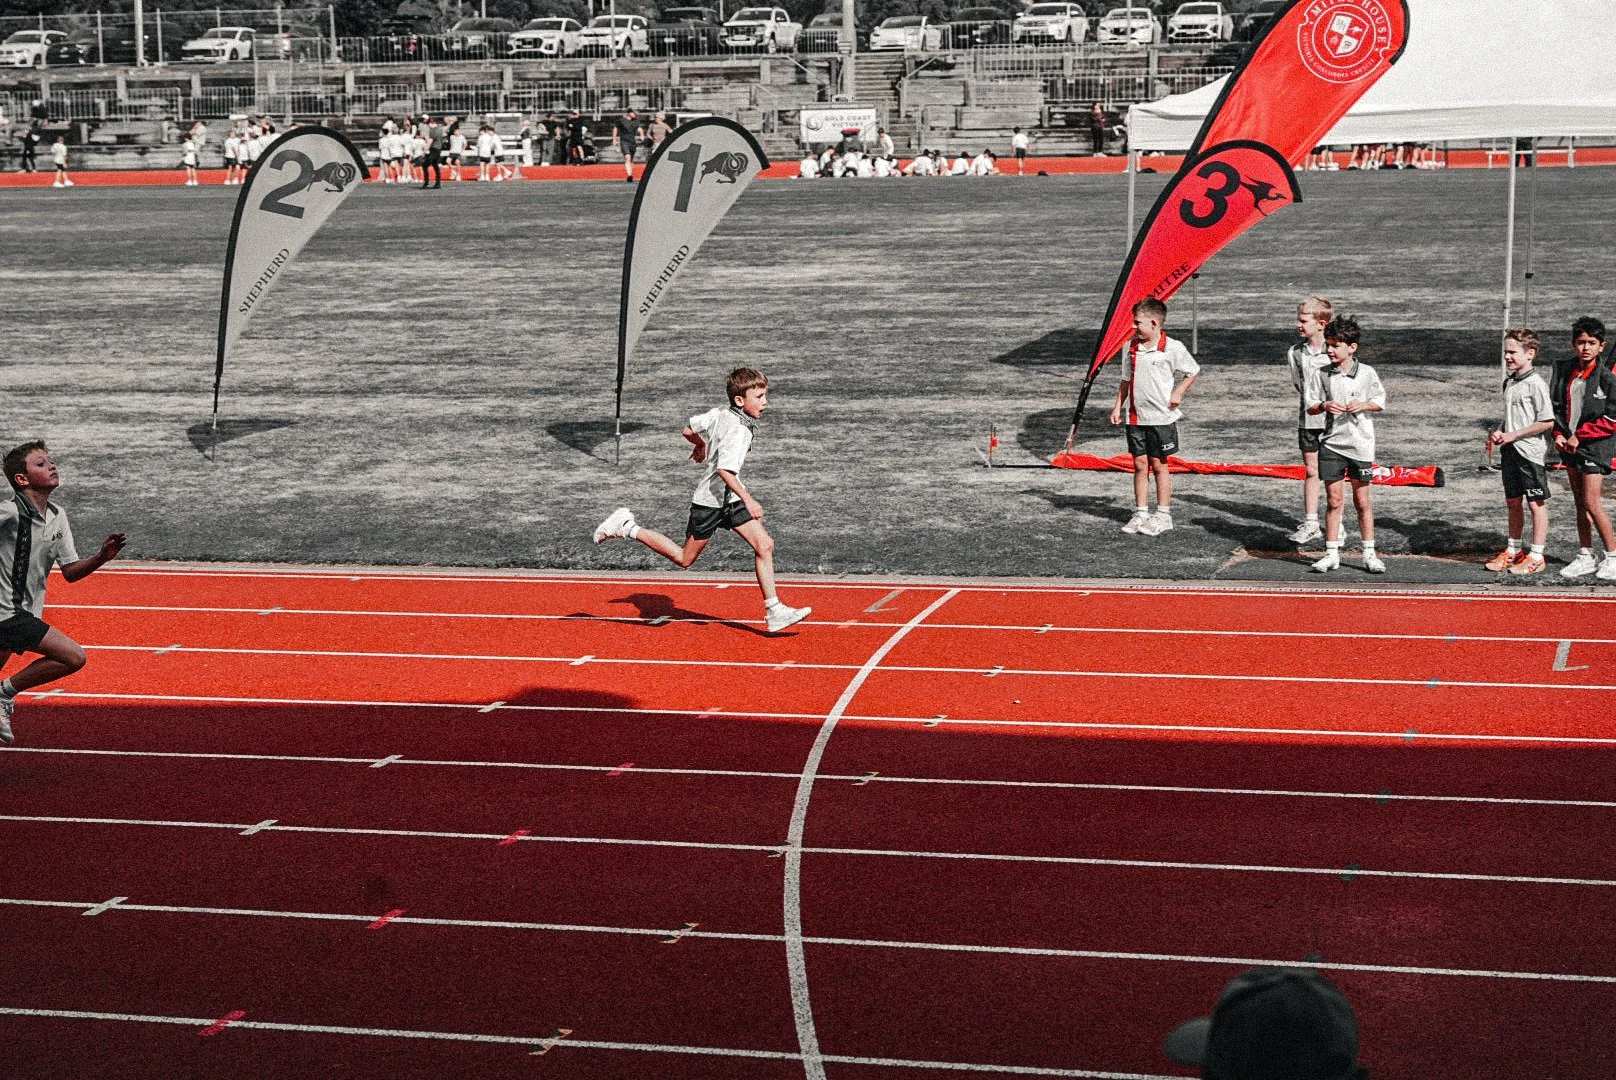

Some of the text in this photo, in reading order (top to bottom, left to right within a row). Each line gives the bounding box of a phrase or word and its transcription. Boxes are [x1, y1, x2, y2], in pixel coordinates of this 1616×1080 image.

[1361, 0, 1388, 43] HOUSE
[259, 149, 314, 219] 2
[667, 143, 702, 213] 1
[1179, 161, 1241, 229] 3
[239, 248, 290, 316] SHEPHERD
[640, 245, 690, 317] SHEPHERD
